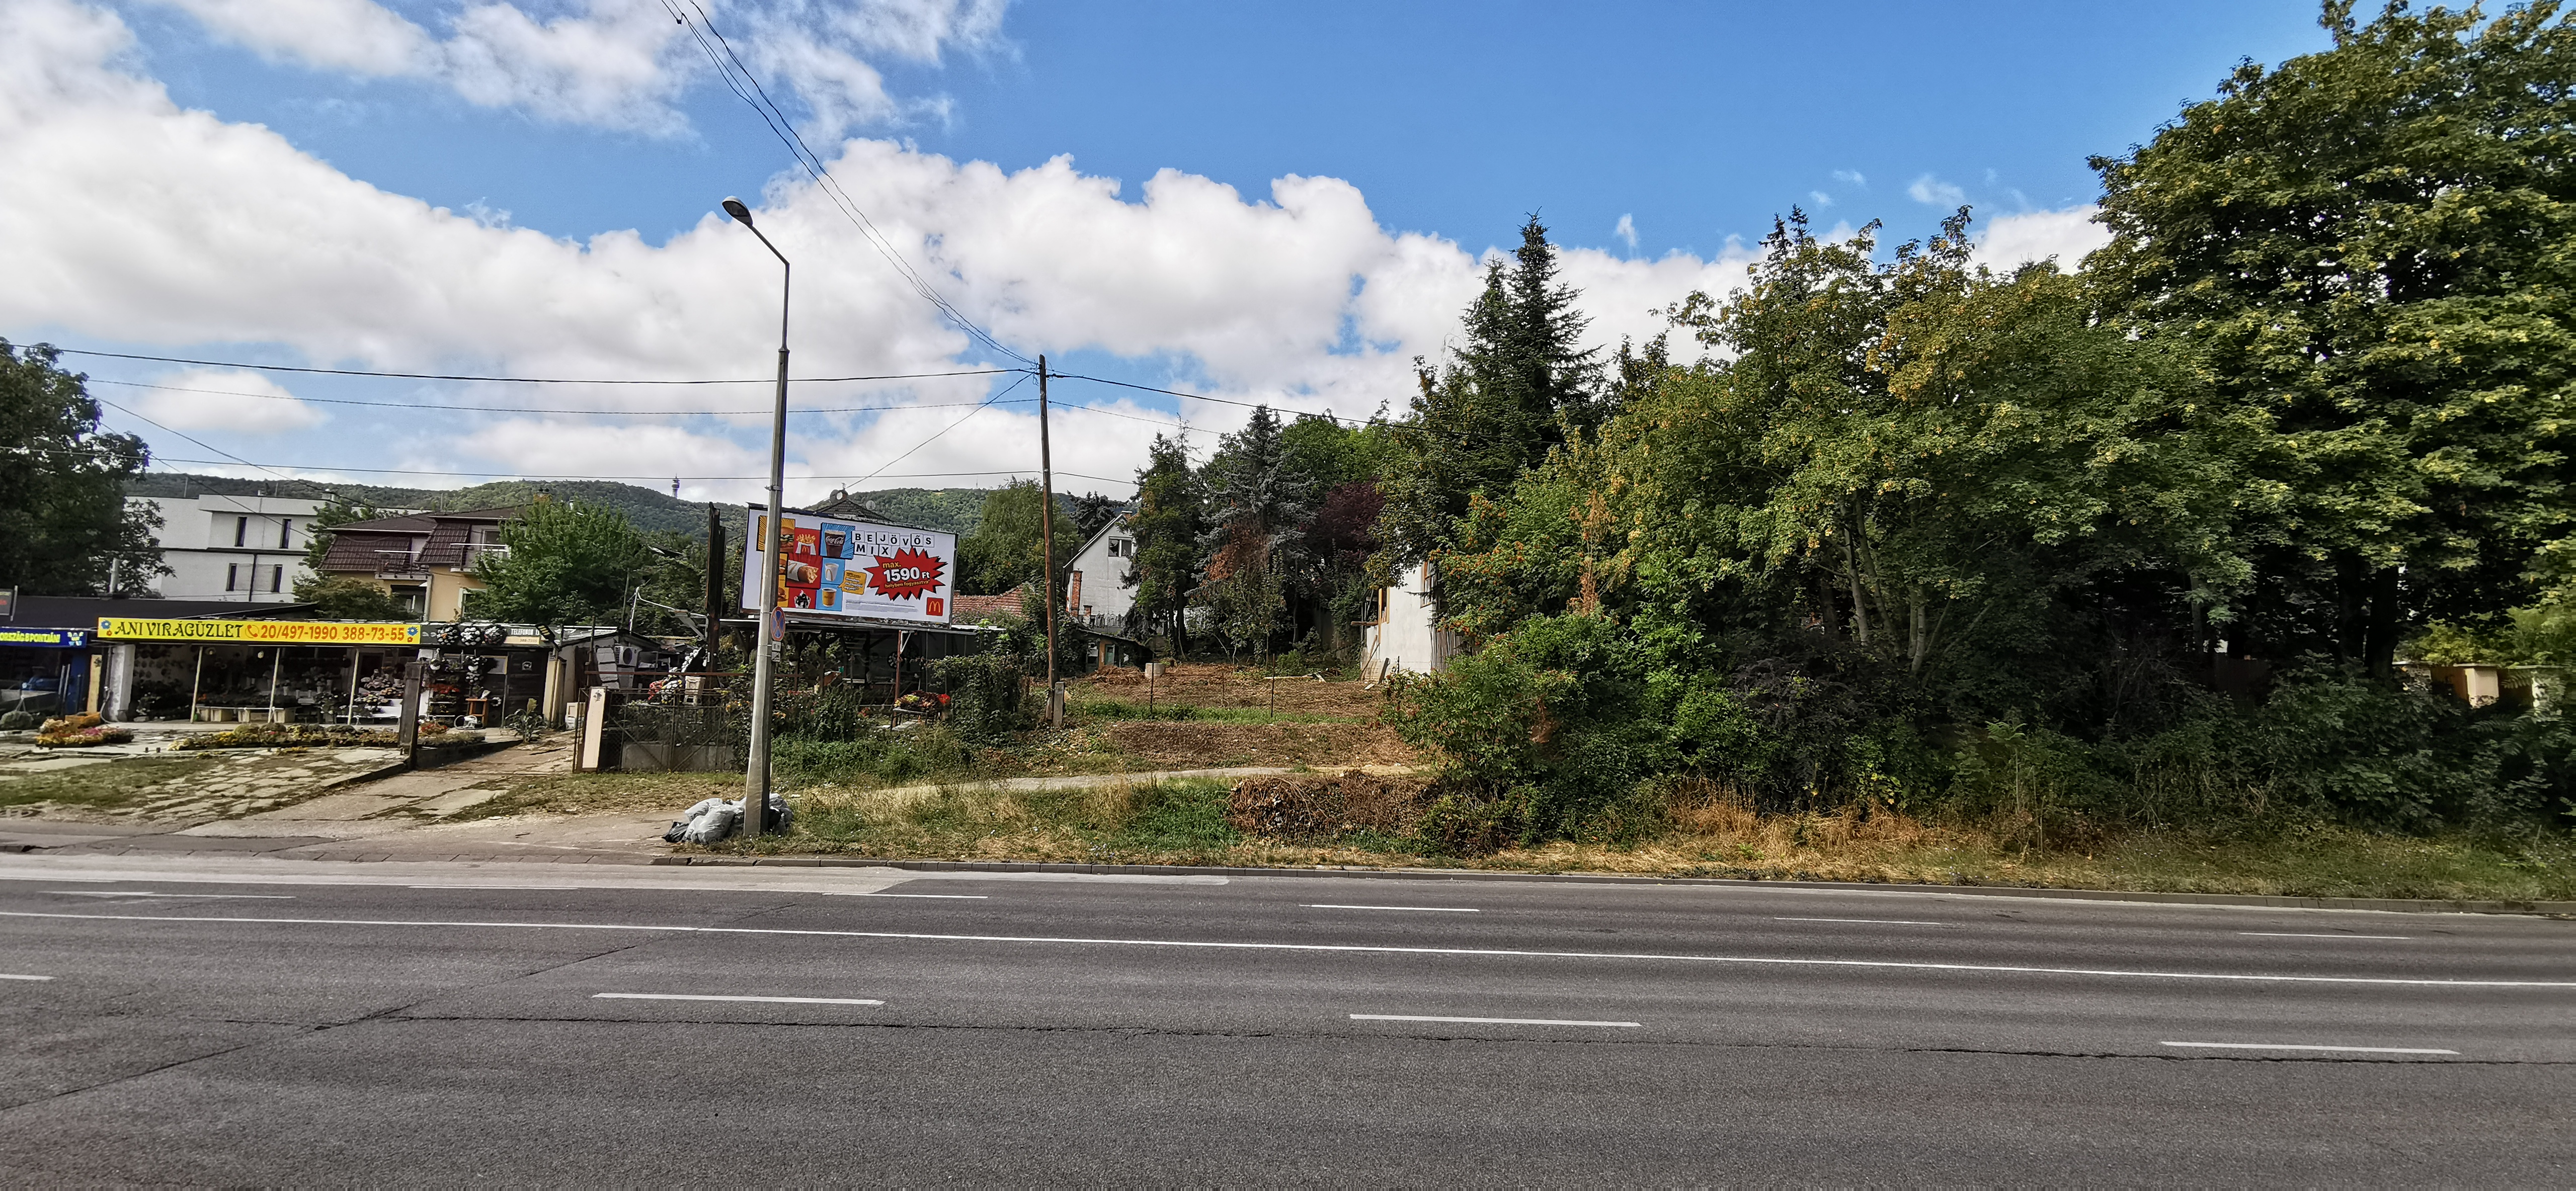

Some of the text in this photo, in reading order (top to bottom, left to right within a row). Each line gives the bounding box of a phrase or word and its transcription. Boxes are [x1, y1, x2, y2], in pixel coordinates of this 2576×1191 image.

[855, 533, 931, 546] BEJÖVŐS
[856, 545, 889, 555] MIX
[883, 567, 920, 582] 1590
[114, 621, 244, 638] ANI VIRÁGÜZLET
[342, 626, 405, 641] 388-73-55
